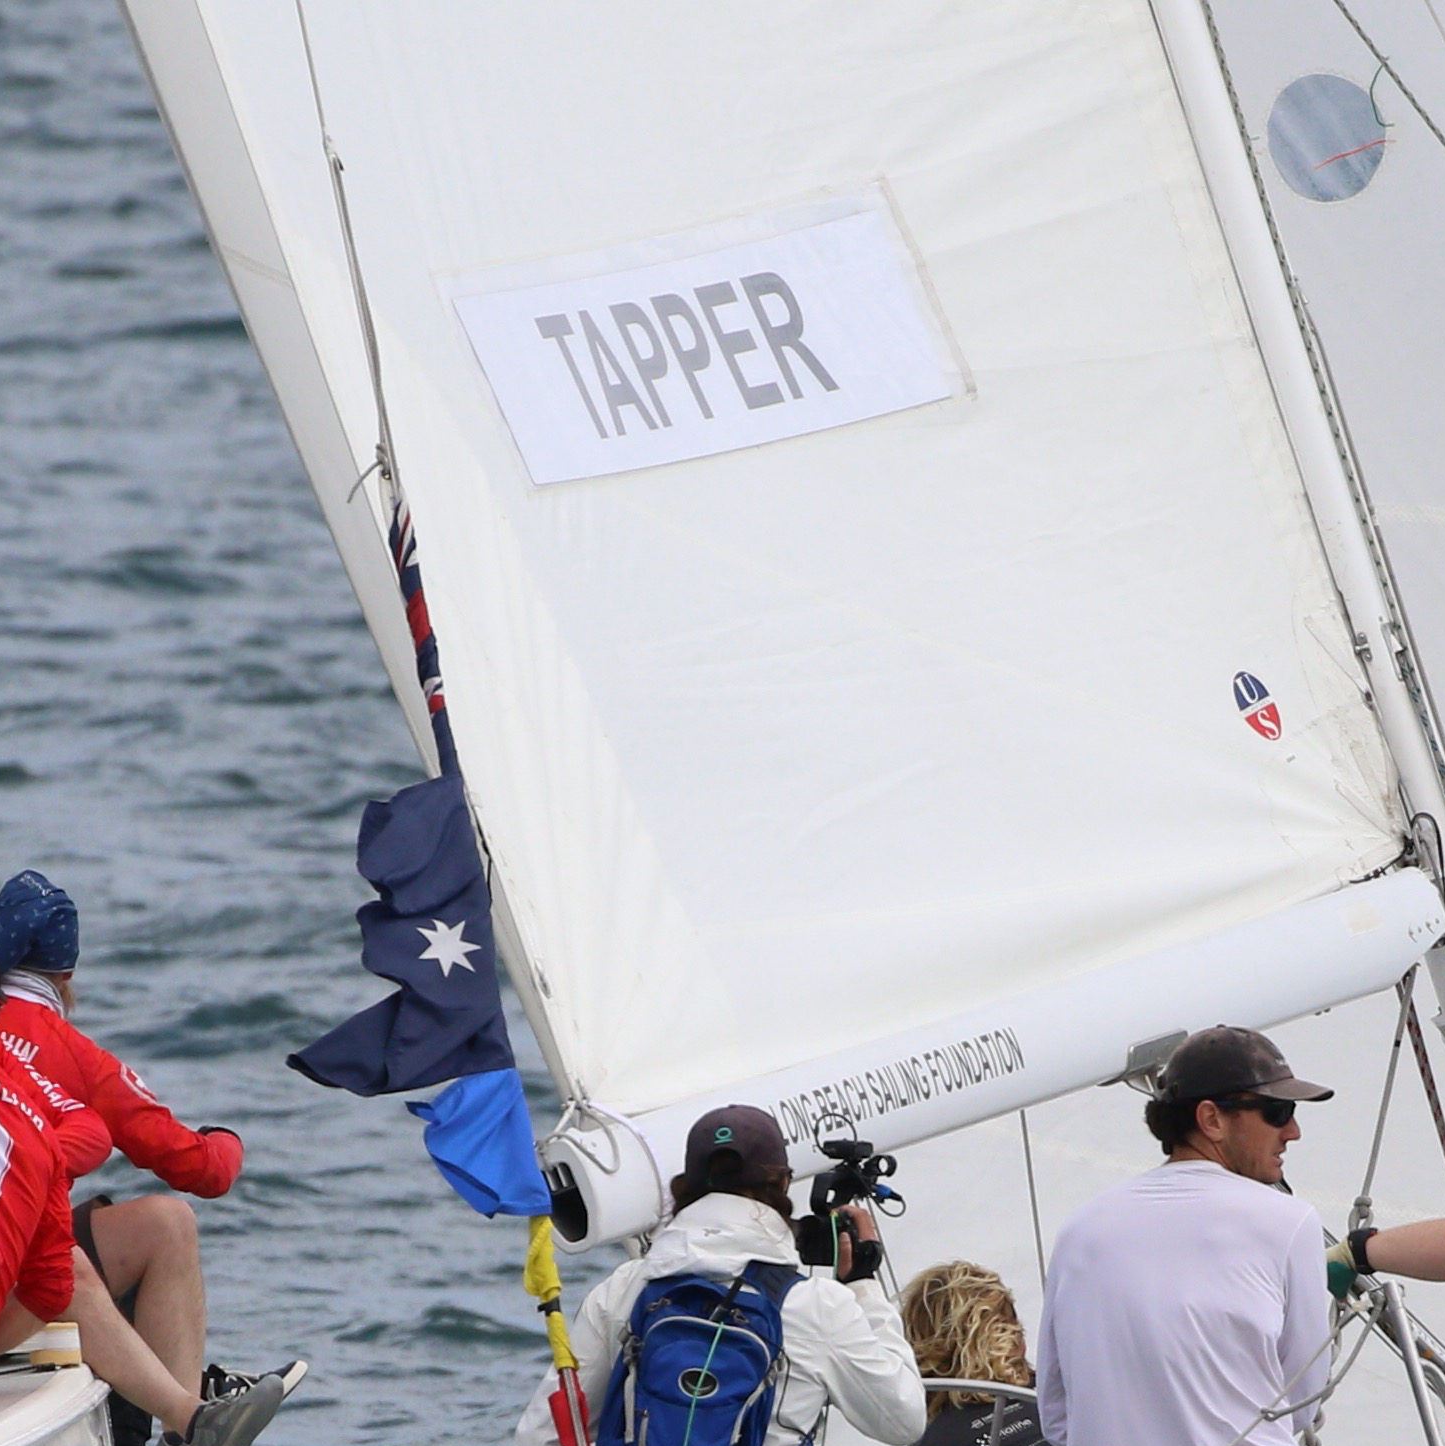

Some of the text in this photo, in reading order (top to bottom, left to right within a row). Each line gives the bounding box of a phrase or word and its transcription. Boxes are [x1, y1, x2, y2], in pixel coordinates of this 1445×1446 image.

[534, 272, 840, 439] TAPPER
[811, 1075, 873, 1132] BEACH
[864, 1056, 931, 1116] SAILING
[922, 1026, 1026, 1096] FOUNDATION
